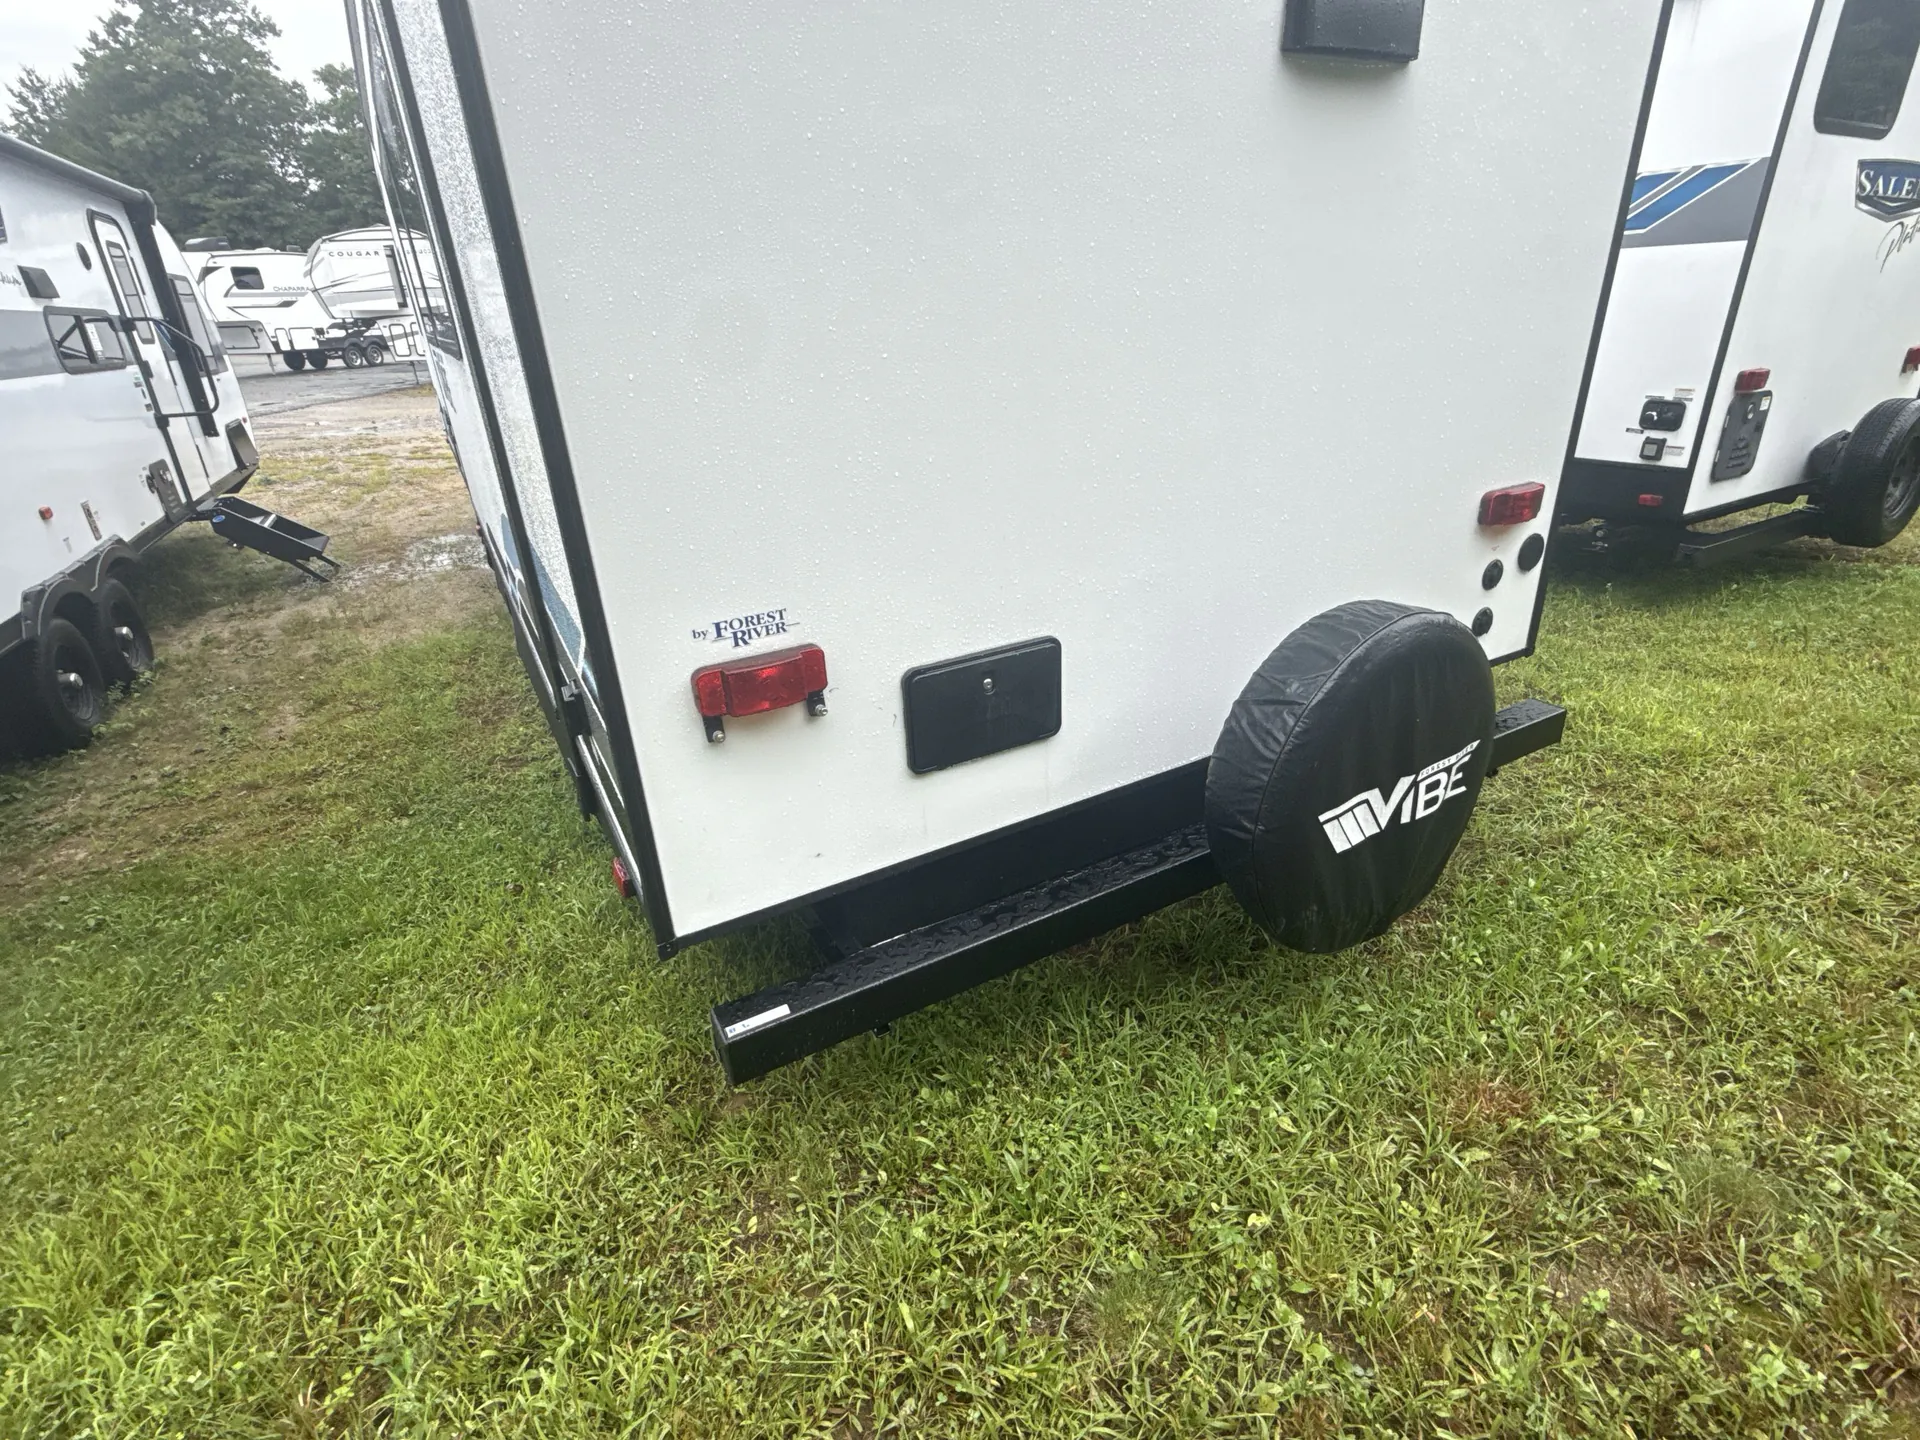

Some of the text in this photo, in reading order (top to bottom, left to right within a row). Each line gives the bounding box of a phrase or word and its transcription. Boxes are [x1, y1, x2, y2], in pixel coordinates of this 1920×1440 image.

[1859, 169, 1920, 199] SALE
[692, 608, 787, 640] by FOREST
[731, 621, 788, 647] RIVER
[1420, 758, 1451, 777] FOREST
[1318, 754, 1472, 830] VIBE
